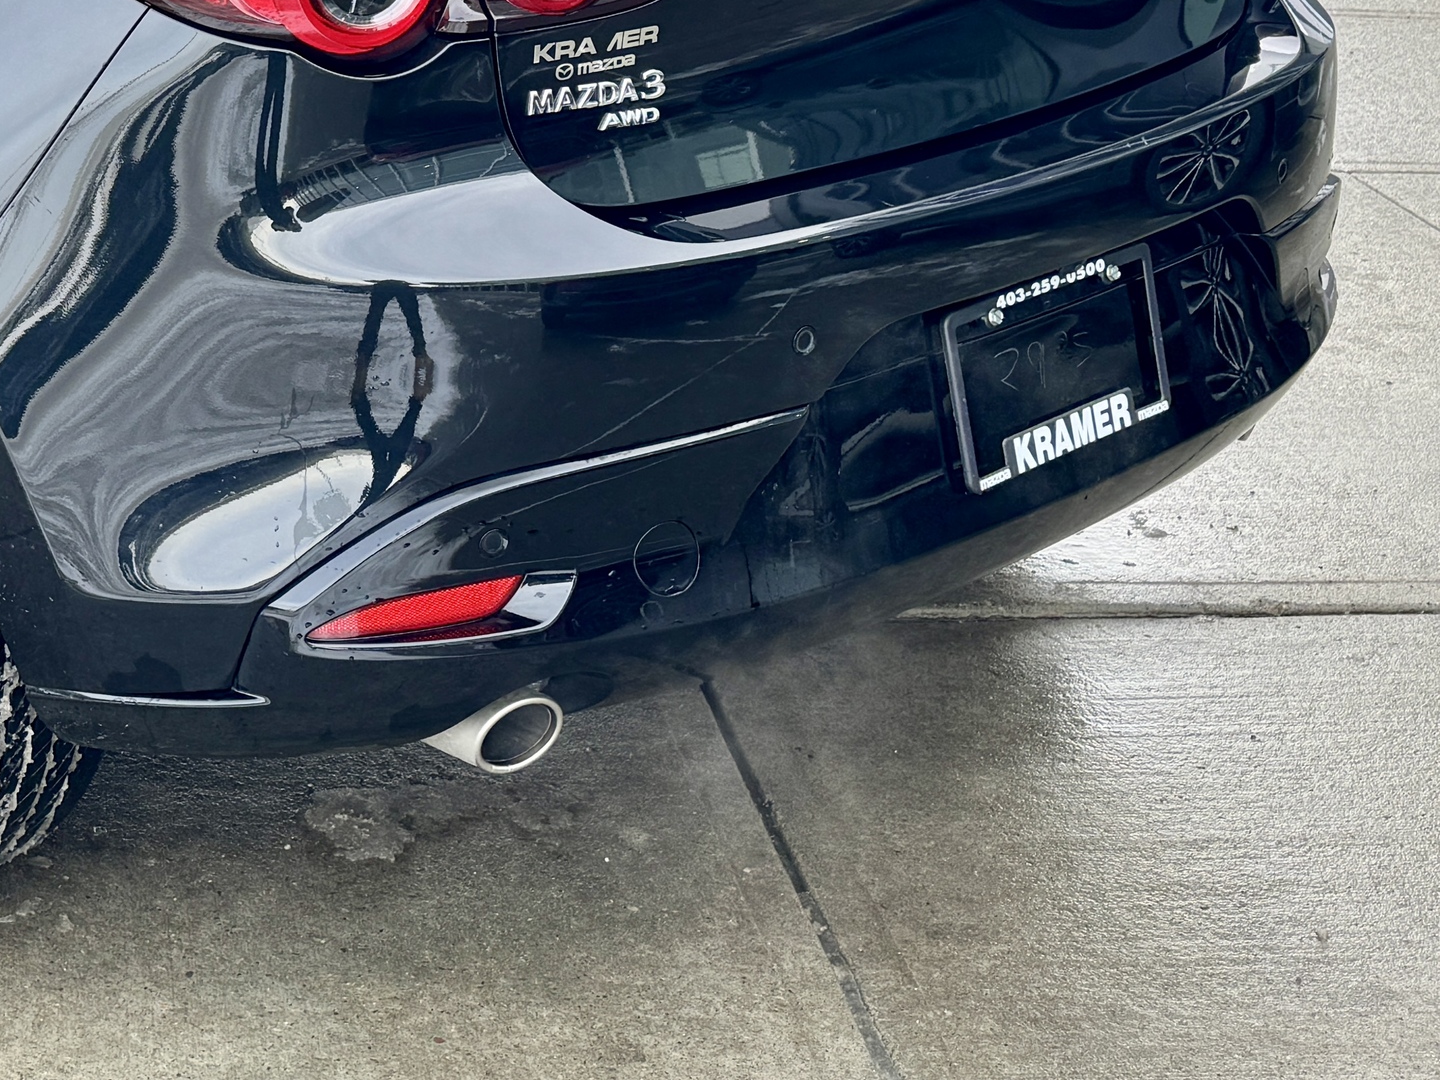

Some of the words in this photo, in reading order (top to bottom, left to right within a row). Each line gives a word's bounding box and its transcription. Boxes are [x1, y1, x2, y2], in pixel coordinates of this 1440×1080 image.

[577, 53, 637, 76] mazda
[597, 107, 660, 131] AWD
[996, 258, 1106, 310] 403-259-0500
[1012, 393, 1132, 474] KRAMER
